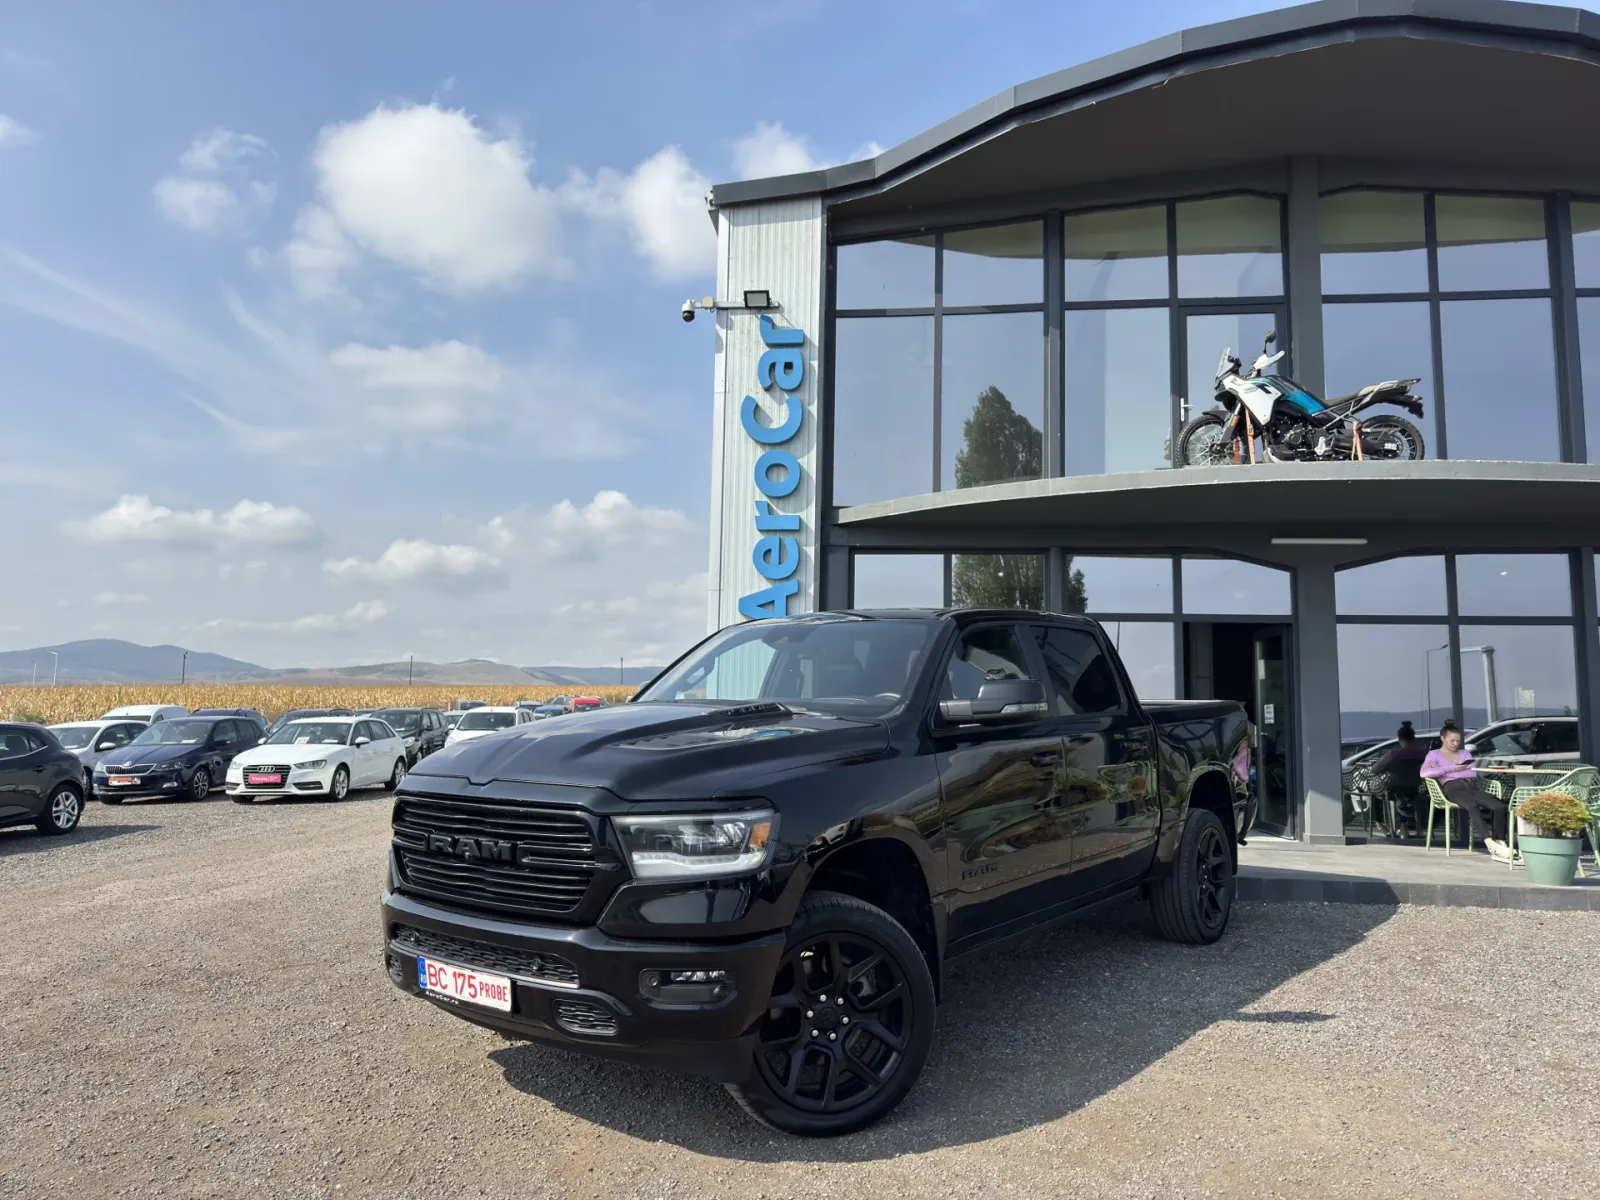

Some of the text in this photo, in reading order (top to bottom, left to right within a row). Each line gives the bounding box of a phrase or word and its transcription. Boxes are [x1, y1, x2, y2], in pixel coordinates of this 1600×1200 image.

[738, 314, 805, 619] AeroCar
[430, 834, 511, 860] RAM
[427, 963, 448, 990] BC
[452, 971, 478, 999] 175
[479, 981, 509, 1003] PROBE
